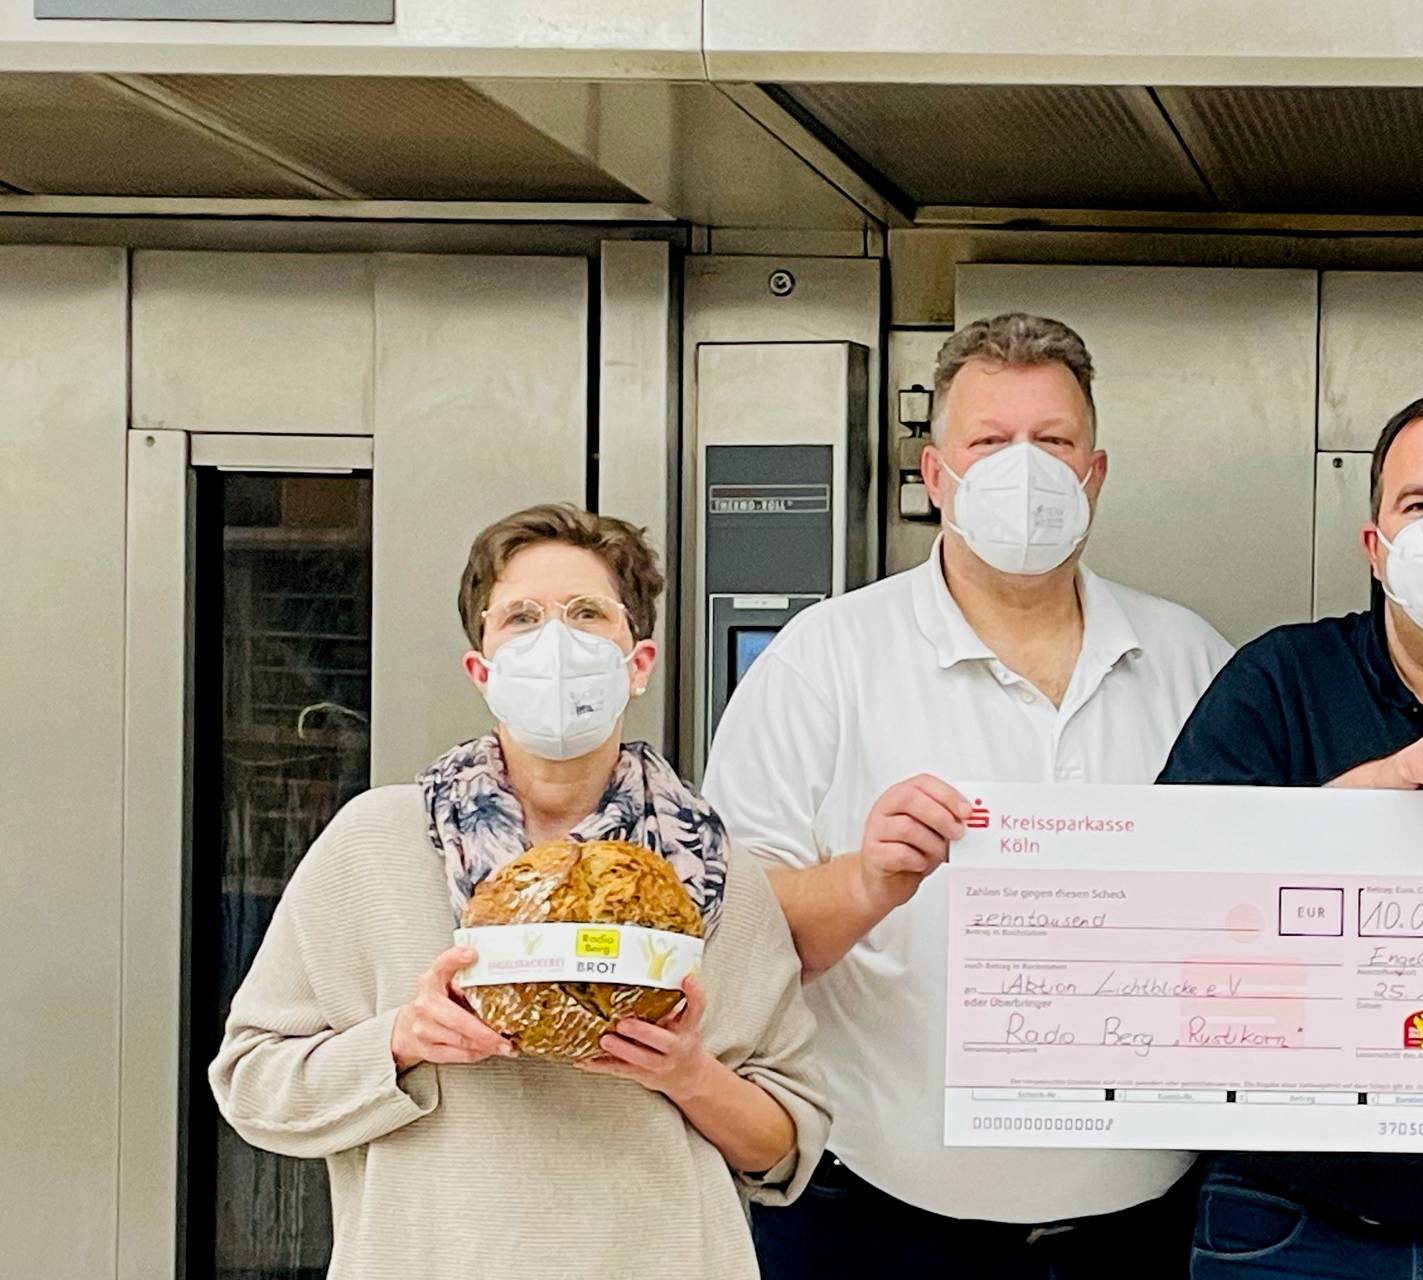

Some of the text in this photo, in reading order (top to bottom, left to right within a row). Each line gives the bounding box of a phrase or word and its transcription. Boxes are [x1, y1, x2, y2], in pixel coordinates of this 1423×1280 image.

[1000, 814, 1136, 835] Kreissparkasse
[1000, 837, 1040, 854] Köln
[1020, 888, 1053, 900] gegen
[1092, 889, 1127, 900] Scheck
[1297, 906, 1326, 918] EUR
[582, 933, 615, 944] Radio
[585, 943, 610, 956] Berg
[576, 960, 617, 974] BROT
[1101, 1016, 1154, 1058] Berg
